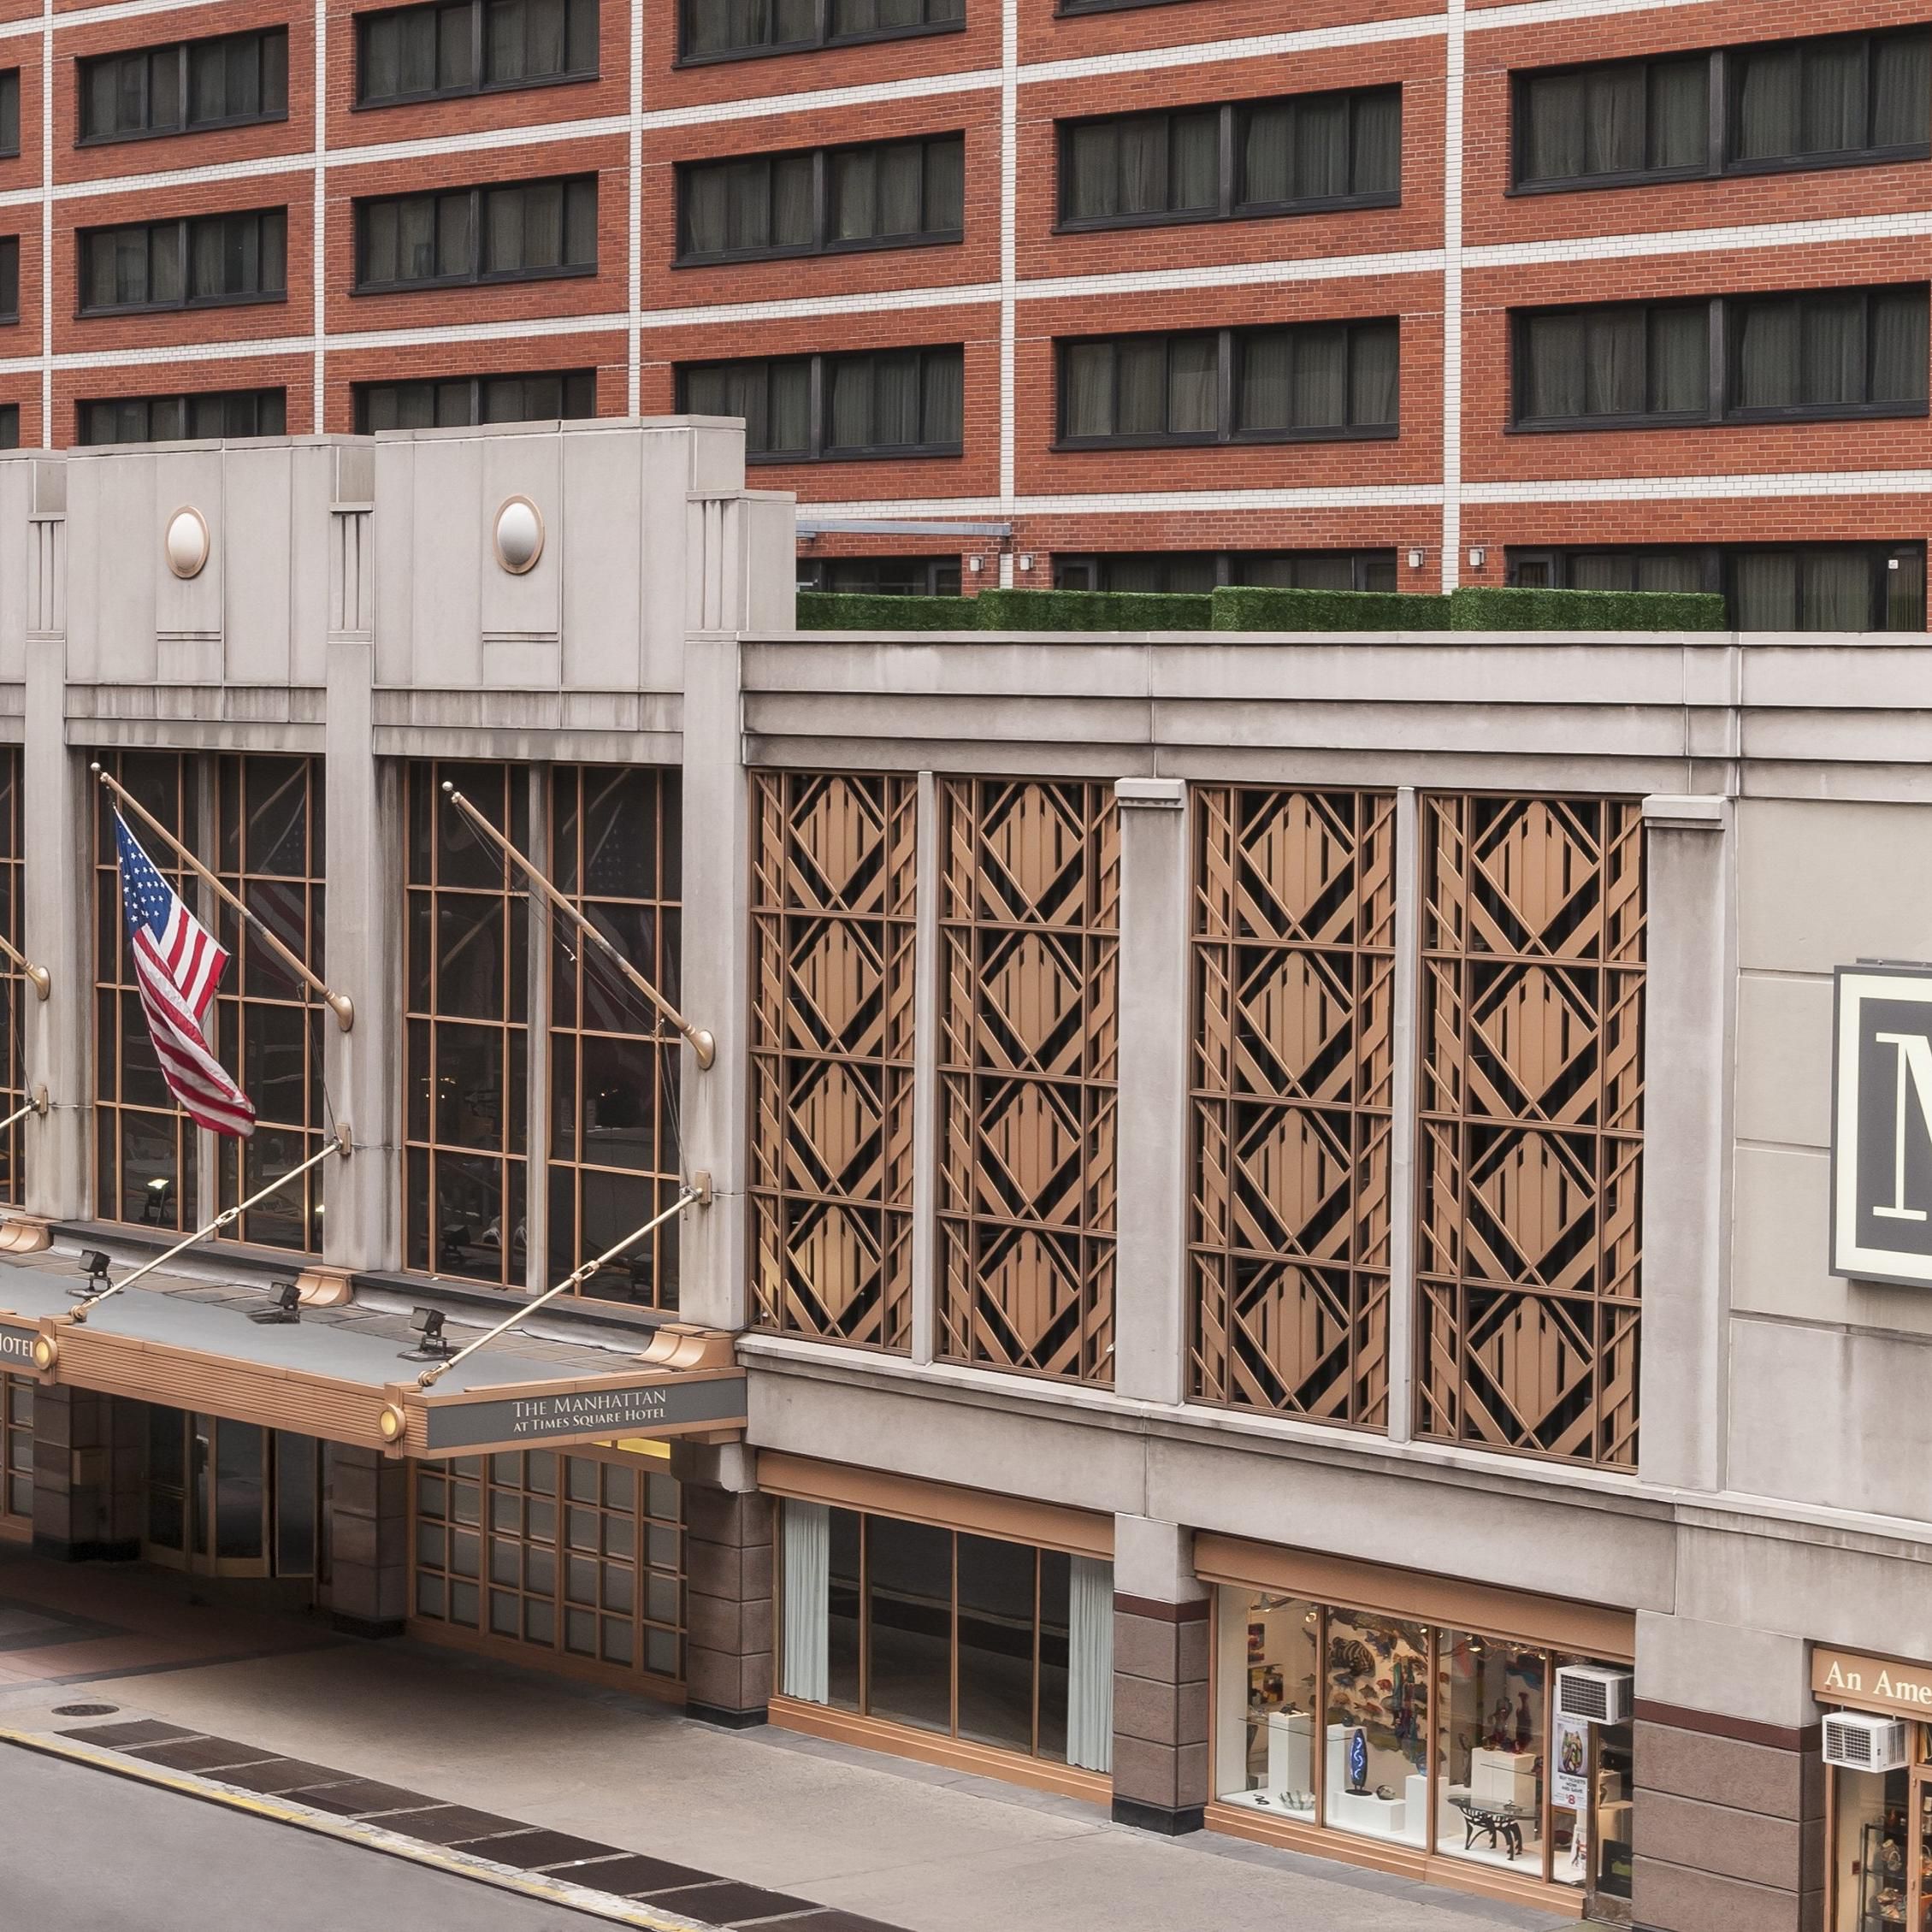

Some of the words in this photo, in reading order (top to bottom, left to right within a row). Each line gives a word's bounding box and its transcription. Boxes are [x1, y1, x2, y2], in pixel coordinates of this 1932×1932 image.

[512, 1401, 547, 1418] THE
[554, 1389, 667, 1414] MANHATTAN
[513, 1421, 529, 1433] AT
[531, 1417, 570, 1431] TIMES
[573, 1412, 622, 1427] SQUARE
[625, 1408, 667, 1421] HOTEL
[1823, 1660, 1862, 1692] An
[1872, 1669, 1932, 1705] Ame
